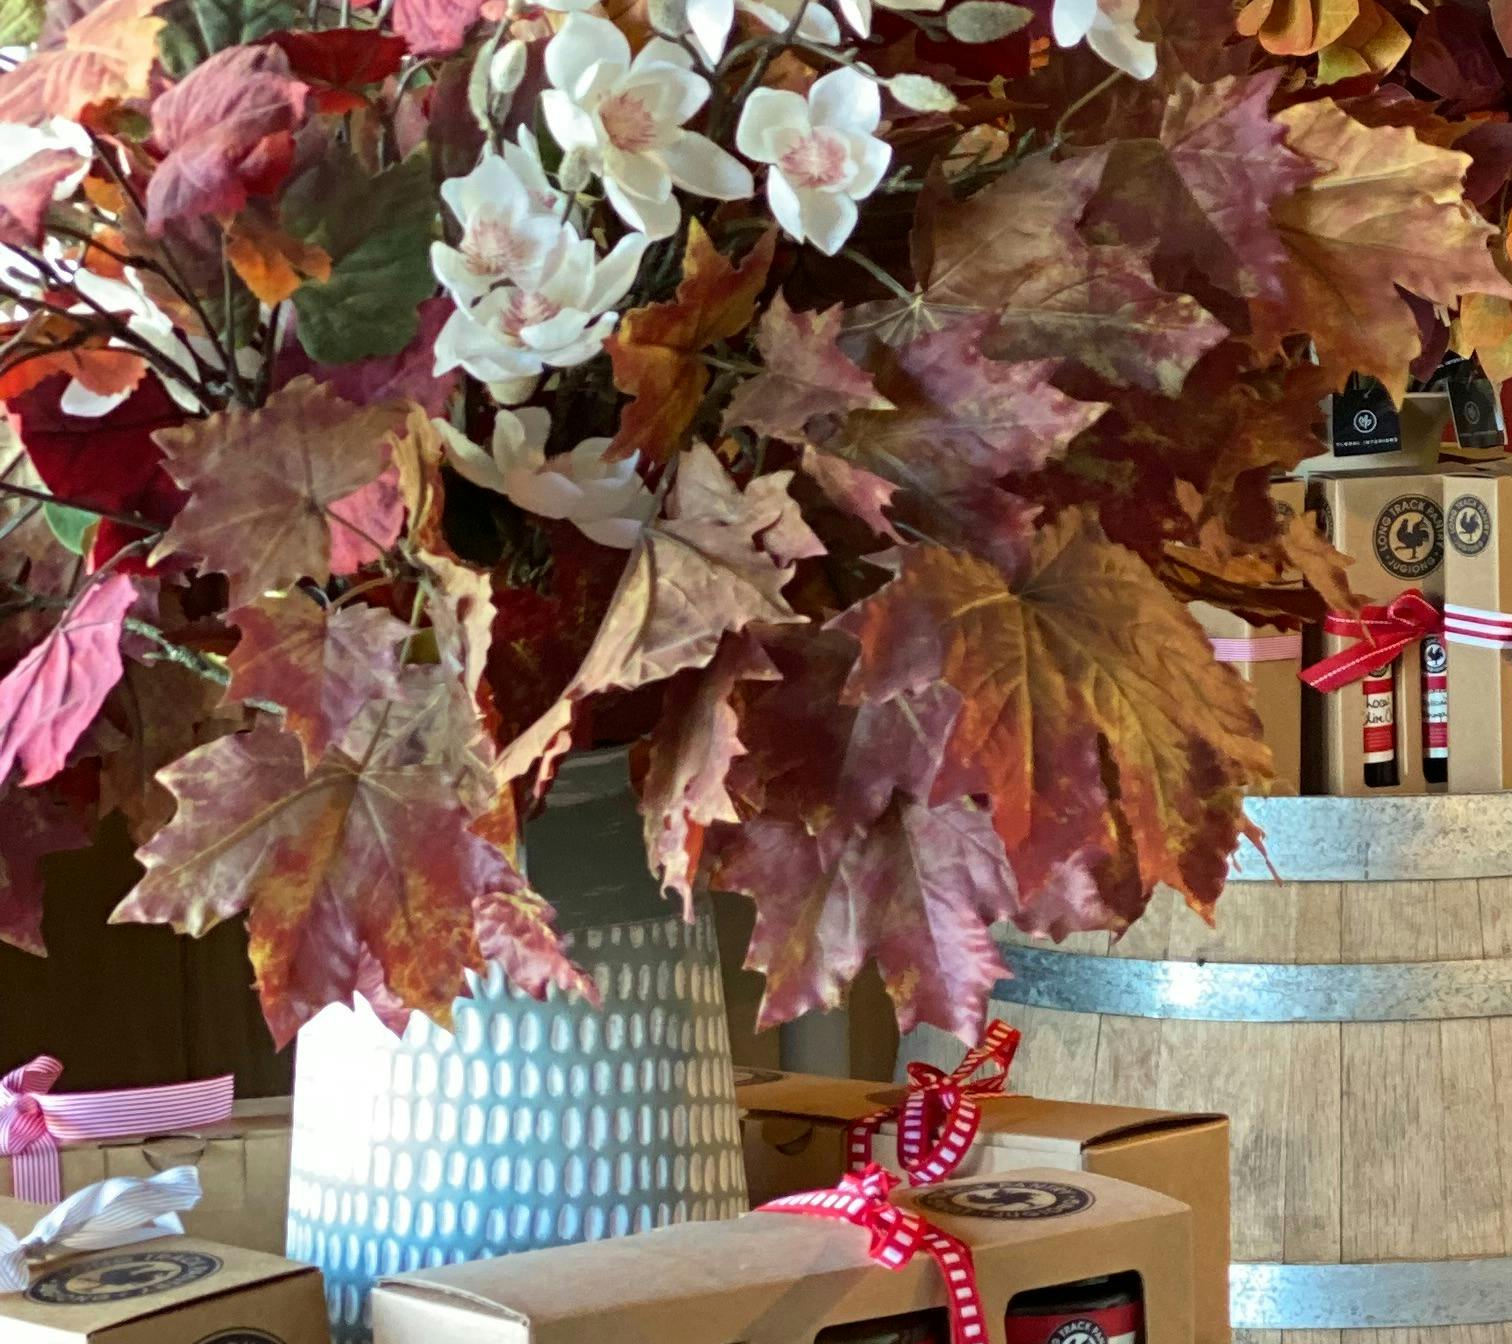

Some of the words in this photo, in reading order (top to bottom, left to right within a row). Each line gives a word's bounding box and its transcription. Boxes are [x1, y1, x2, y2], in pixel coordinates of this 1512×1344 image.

[1378, 516, 1392, 552] LONG
[1392, 499, 1425, 519] TRACK
[1388, 556, 1436, 574] JUGIONG
[1058, 1321, 1091, 1337] TRACK
